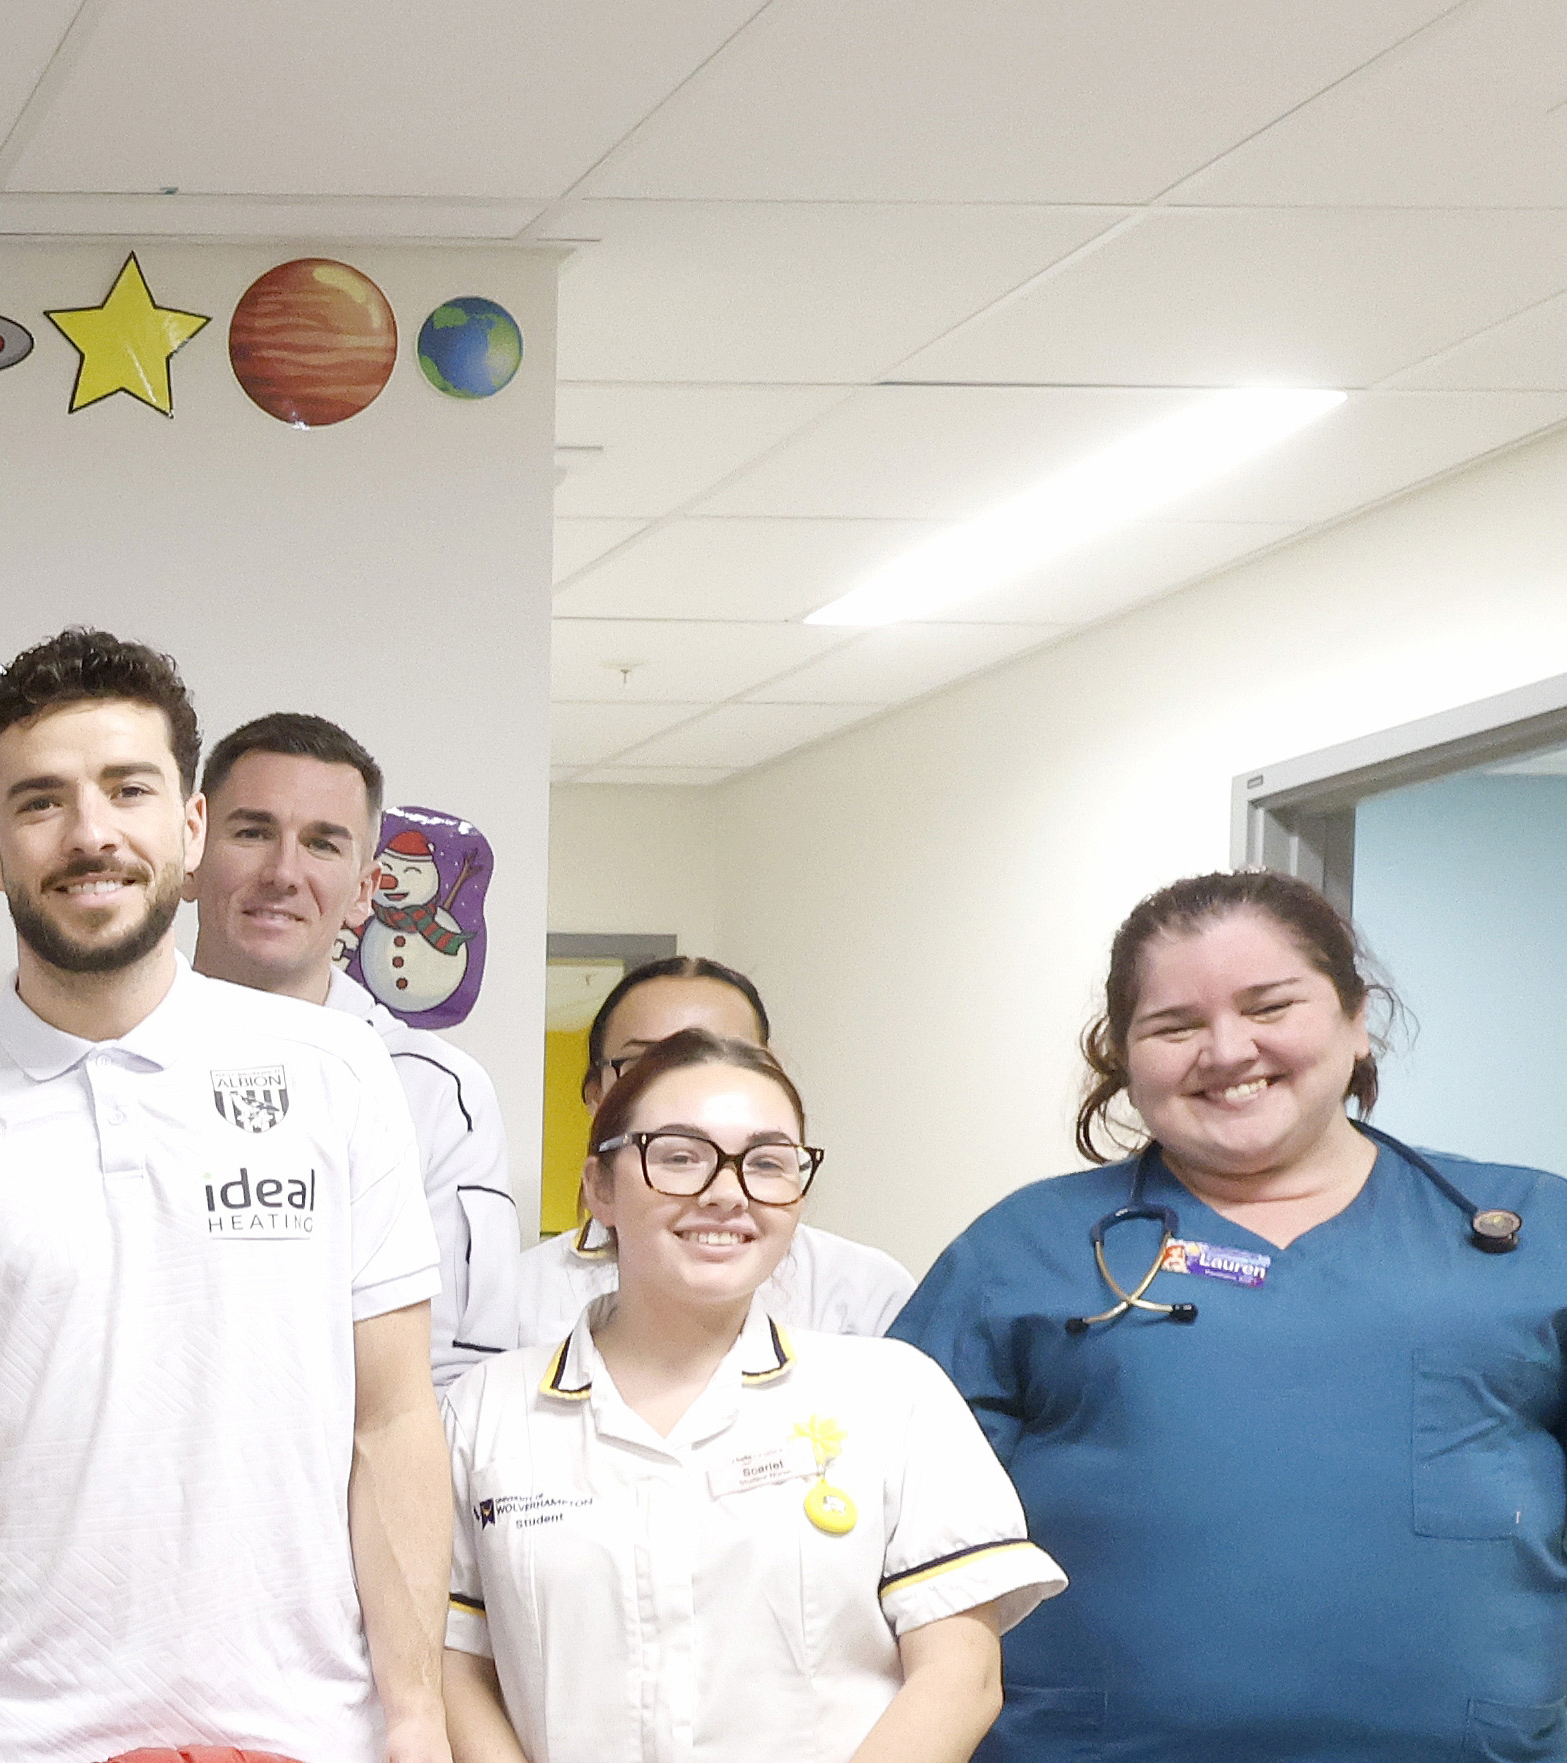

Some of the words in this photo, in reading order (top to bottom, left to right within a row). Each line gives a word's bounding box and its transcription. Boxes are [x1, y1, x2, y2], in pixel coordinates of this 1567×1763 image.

[217, 1074, 282, 1088] ALBION
[203, 1167, 315, 1212] ideal
[209, 1213, 314, 1233] HEATING
[1199, 1253, 1266, 1279] Lauren
[742, 1460, 784, 1477] Scarlet
[515, 1512, 564, 1529] Student
